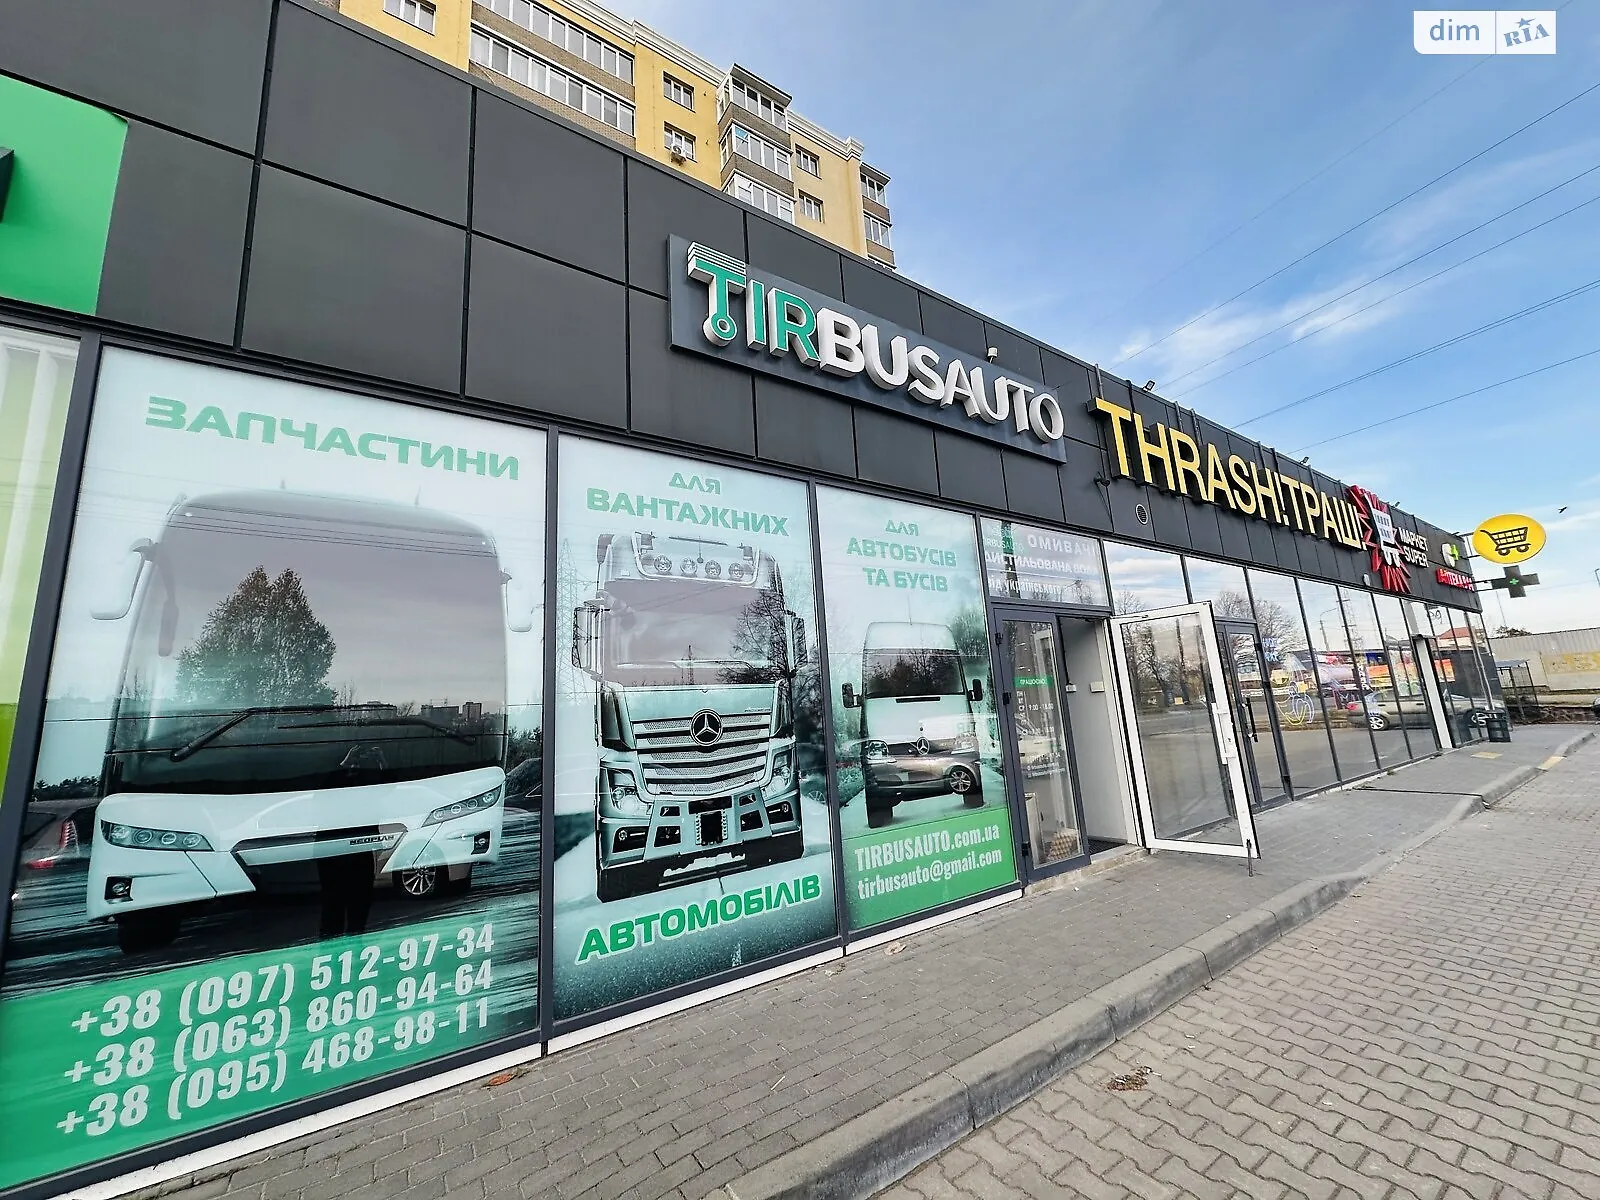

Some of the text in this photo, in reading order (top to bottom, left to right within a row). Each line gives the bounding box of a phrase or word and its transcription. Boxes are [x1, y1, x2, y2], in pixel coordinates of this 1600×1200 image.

[687, 241, 1065, 443] TIRBUSAUTO
[145, 396, 519, 480] ЗАПЧАСТИНИ
[668, 471, 721, 495] ДЛЯ
[586, 487, 789, 537] ВАНТАЖНИХ
[885, 518, 920, 537] ДЛЯ
[846, 537, 957, 568] АВТОБУСІВ
[1403, 546, 1429, 567] SUPER
[863, 567, 948, 592] ТА БУСІВ
[854, 822, 1000, 872] TIRBUSAUTO.com.ua
[857, 847, 1002, 900] tirbusauto@gmail.com
[576, 874, 821, 964] АВТОМОБІЛІВ
[71, 923, 495, 1037] +38 (097) 512-97-34
[64, 959, 493, 1086] +38 (063) 860-94-64
[57, 996, 488, 1136] +38 (095) 468-98-11
